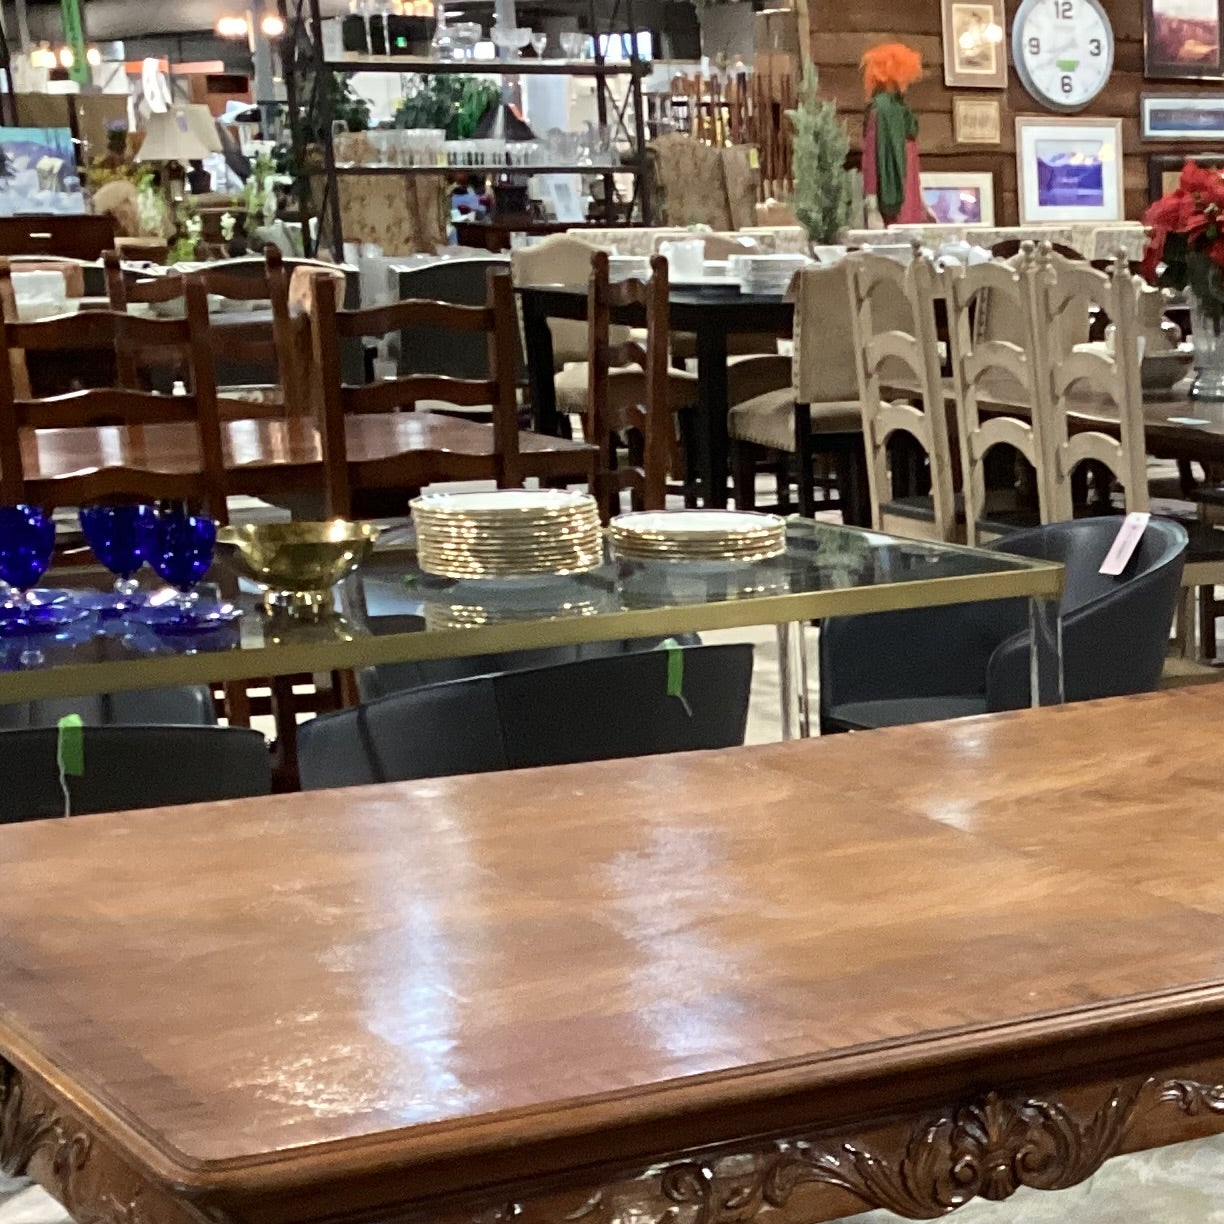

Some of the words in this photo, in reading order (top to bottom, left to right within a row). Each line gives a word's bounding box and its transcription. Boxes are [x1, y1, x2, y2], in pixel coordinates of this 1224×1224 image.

[1054, 1, 1073, 19] 12
[1028, 37, 1040, 55] 9
[1089, 39, 1102, 56] 3
[1061, 75, 1073, 93] 6
